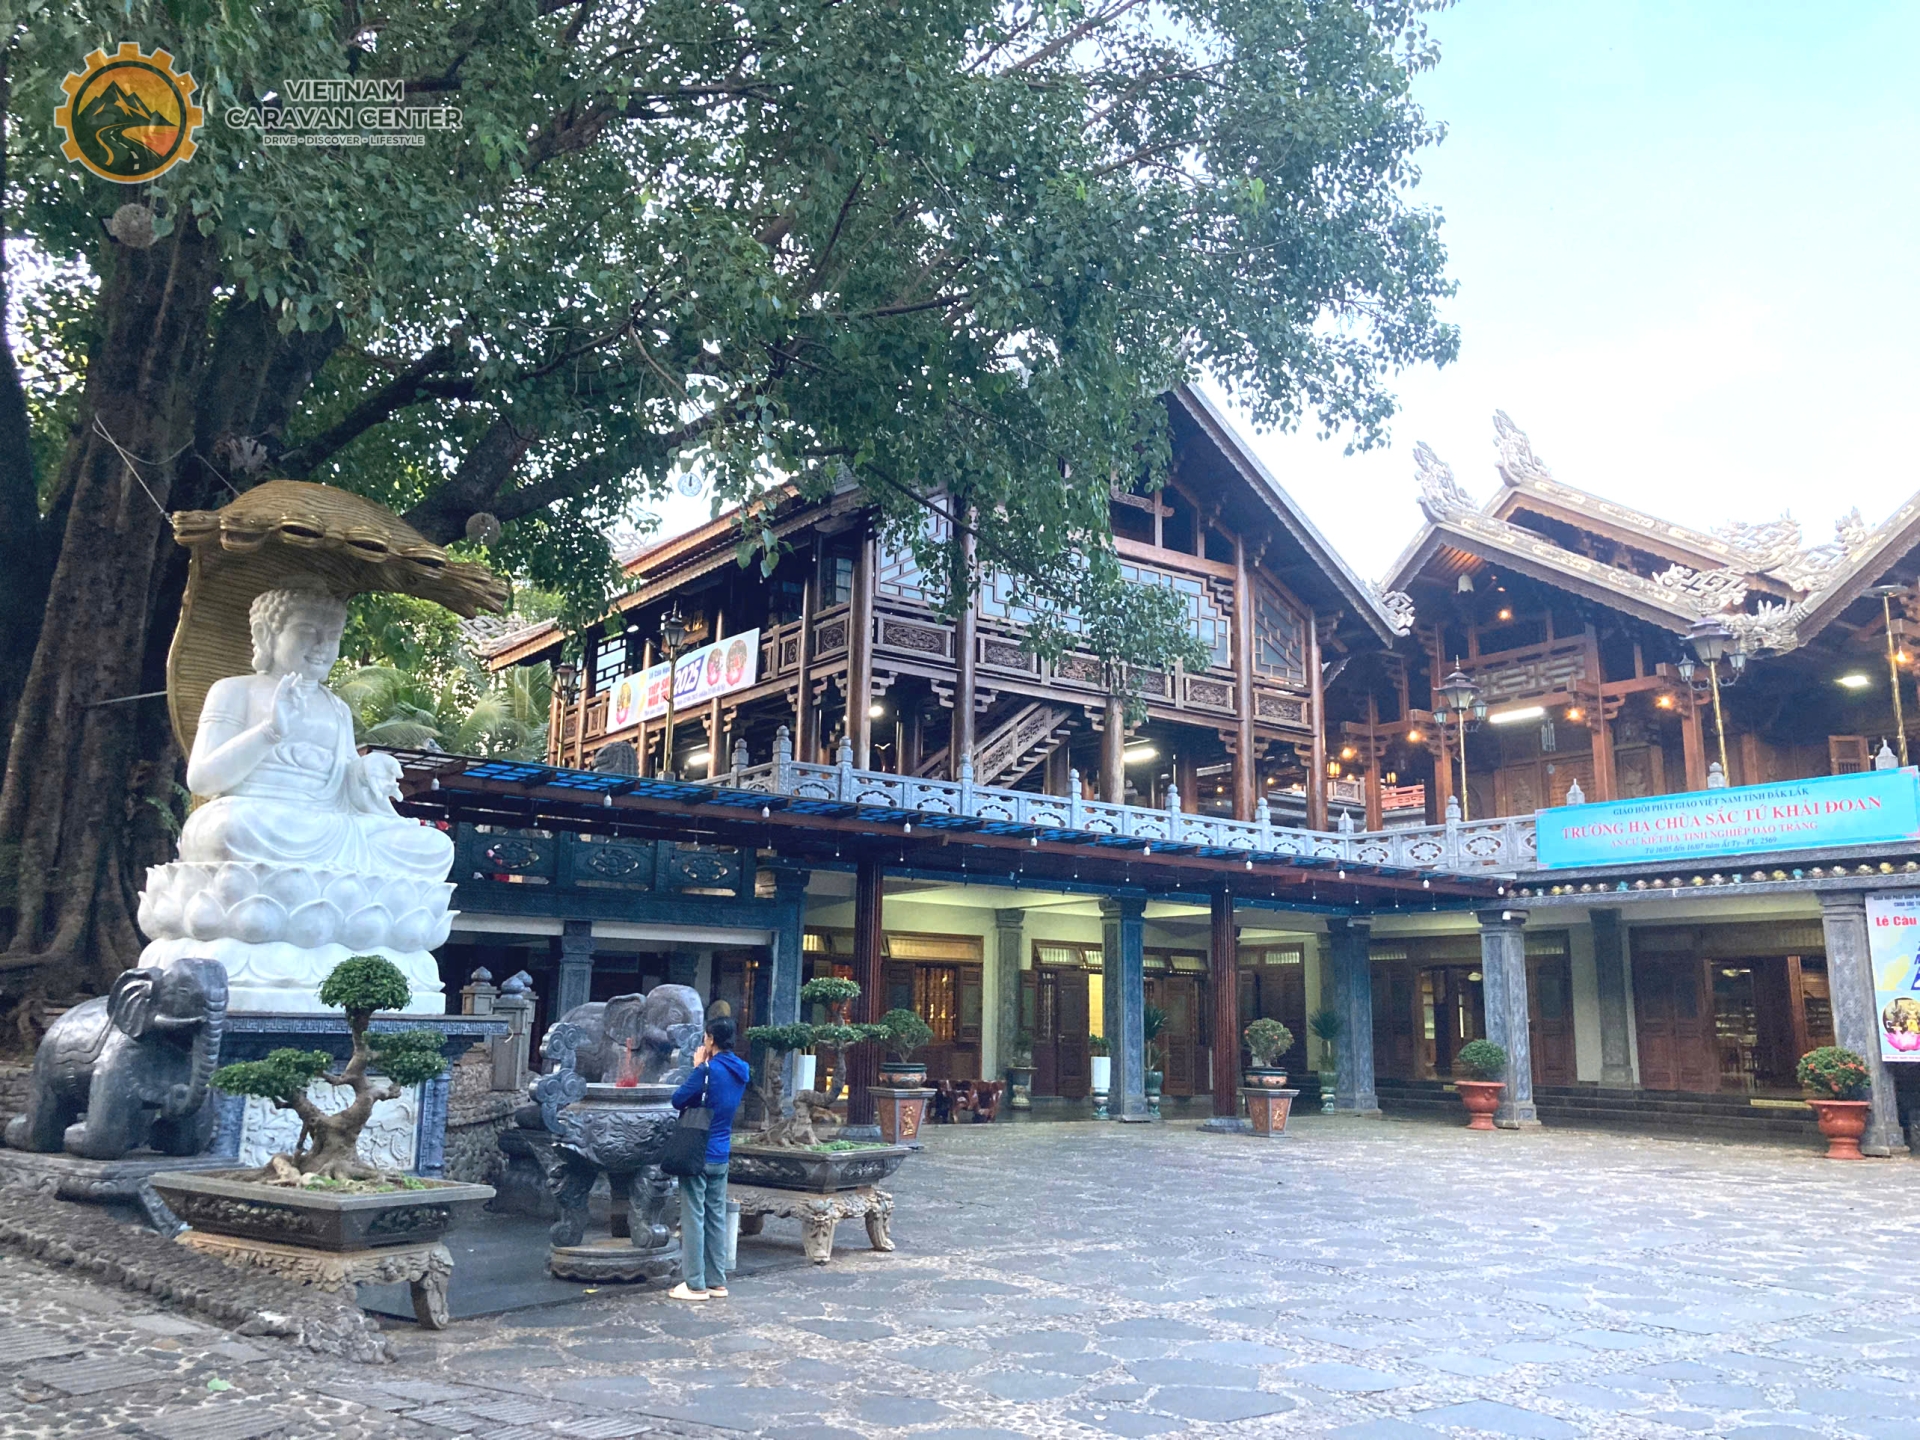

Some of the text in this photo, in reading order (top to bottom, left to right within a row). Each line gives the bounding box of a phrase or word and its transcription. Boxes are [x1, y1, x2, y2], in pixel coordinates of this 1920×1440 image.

[674, 659, 701, 695] 2025
[1562, 795, 1881, 839] TRƯỜNG HẠ CHÙA SẮC TỨ KHẢI ĐOAN
[1613, 806, 1634, 816] GIÁO
[1675, 800, 1697, 809] GIÁO
[1699, 797, 1719, 808] VIỆT
[1721, 797, 1741, 805] NAM
